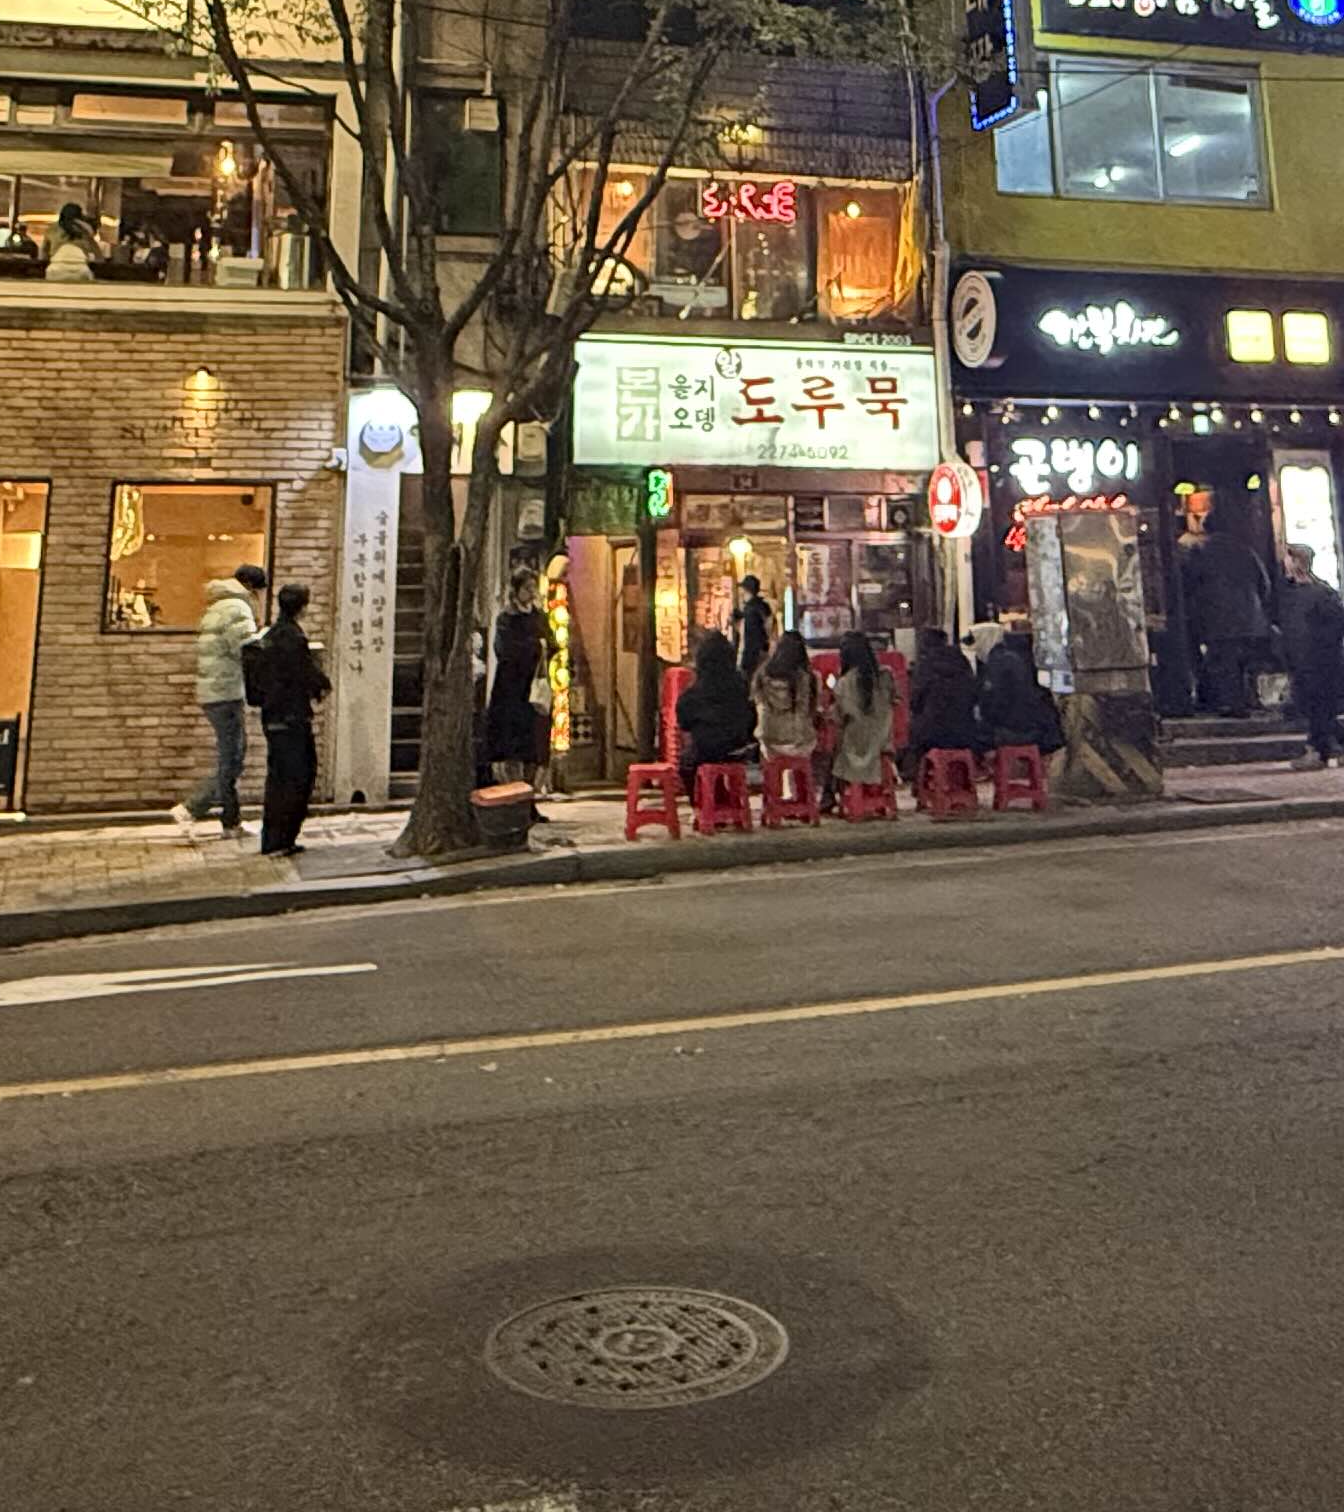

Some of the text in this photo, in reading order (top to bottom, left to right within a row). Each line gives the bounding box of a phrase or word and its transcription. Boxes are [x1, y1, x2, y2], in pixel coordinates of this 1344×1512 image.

[667, 373, 717, 402] 을지
[731, 376, 909, 430] 도루묵
[667, 406, 717, 433] 오뎅
